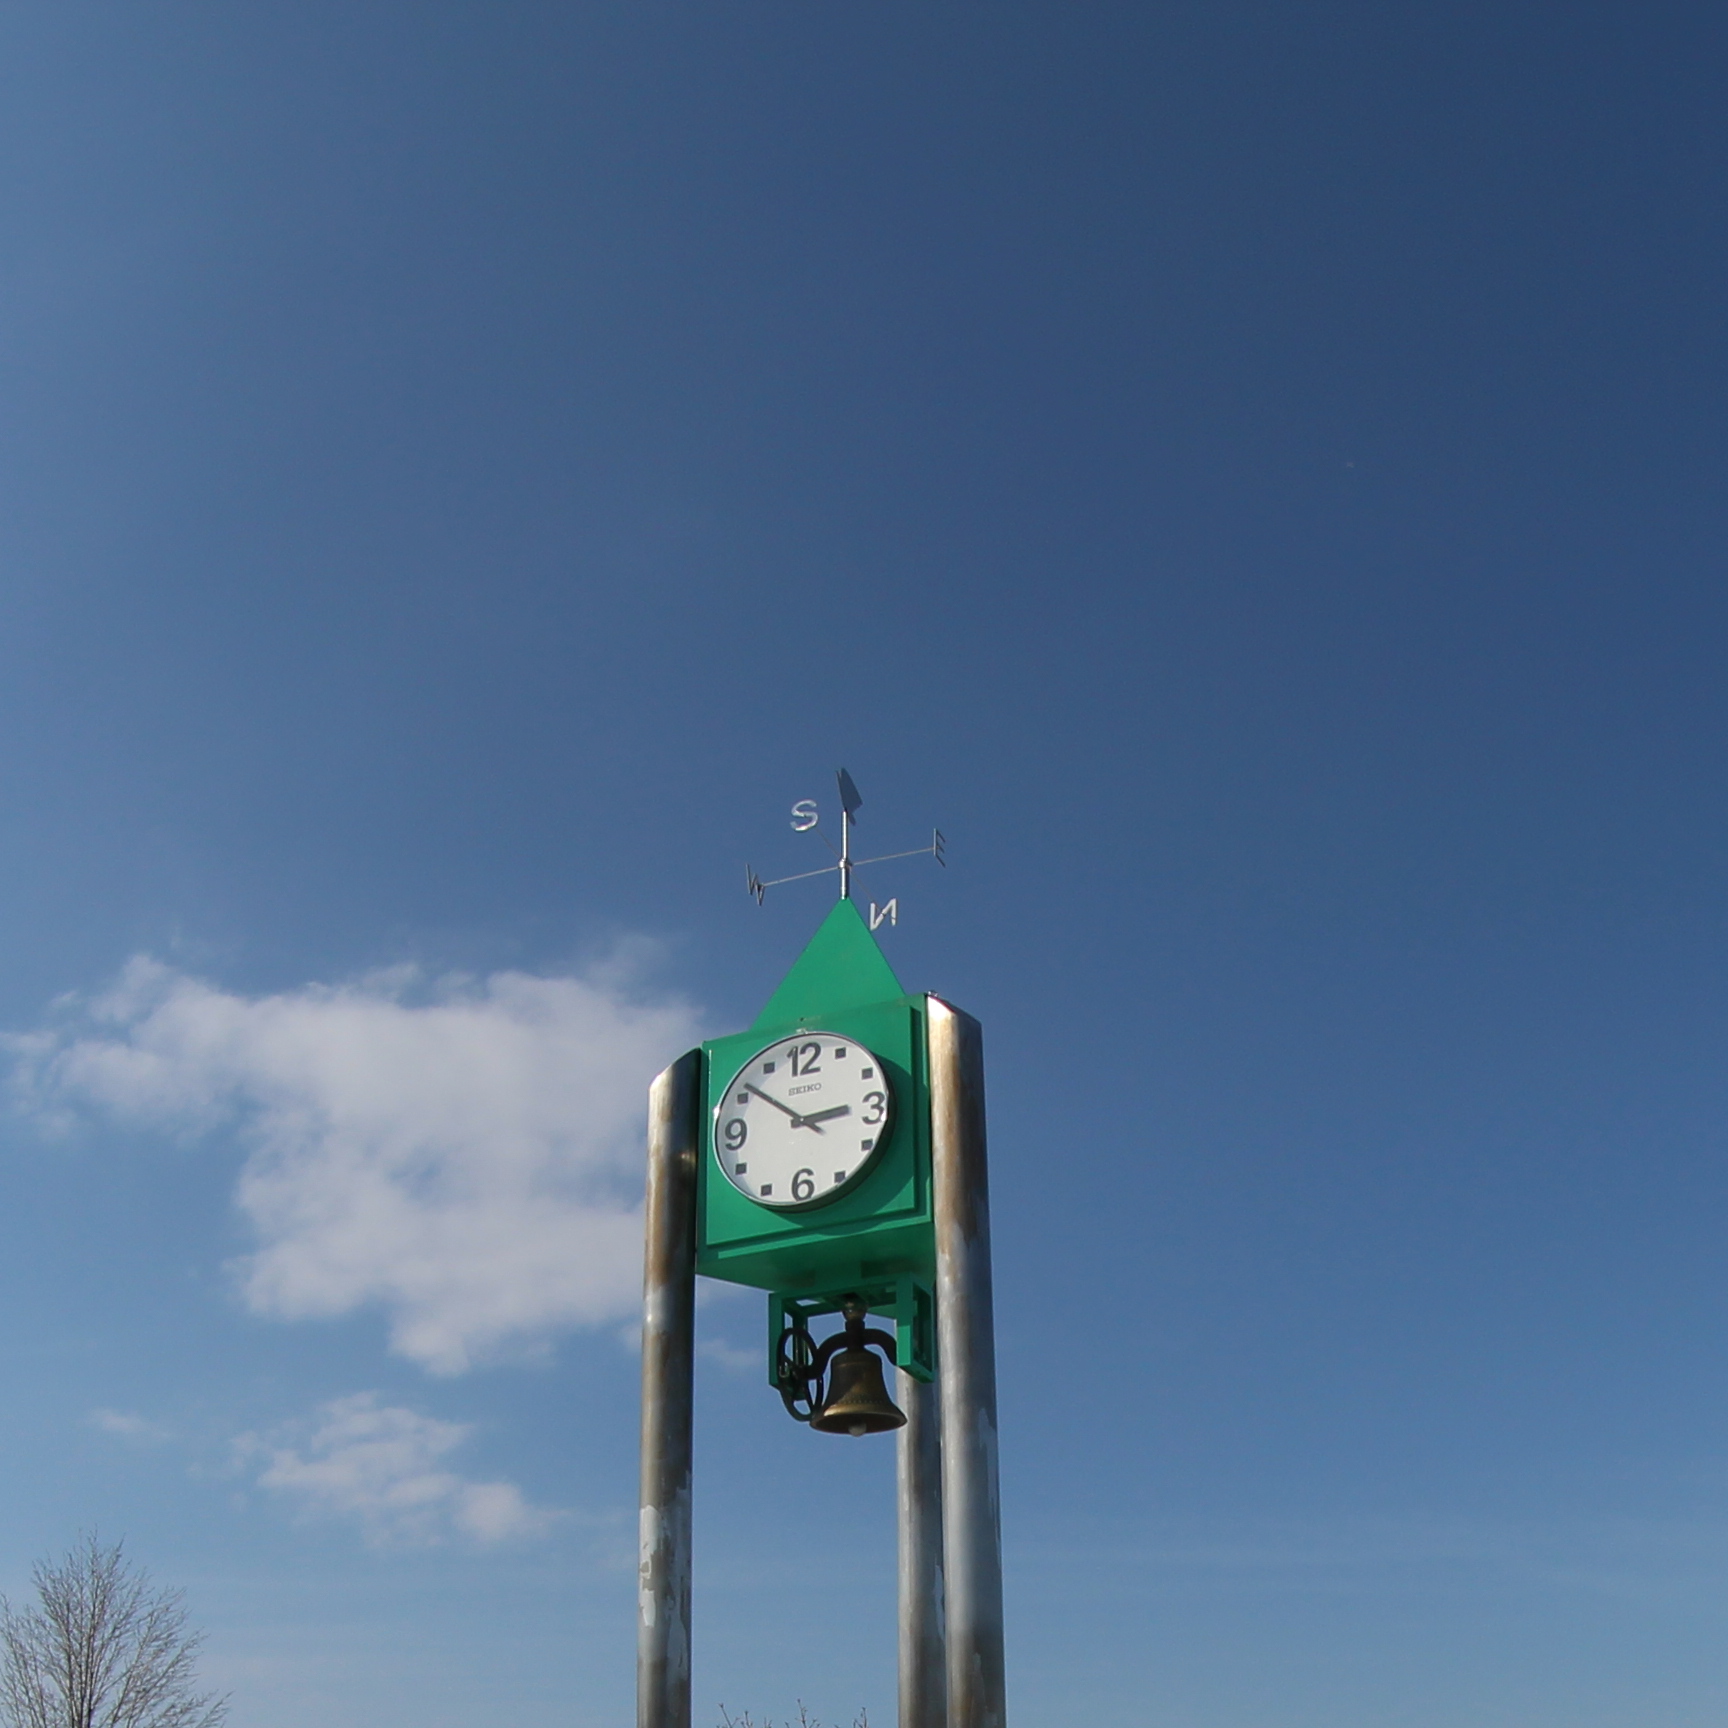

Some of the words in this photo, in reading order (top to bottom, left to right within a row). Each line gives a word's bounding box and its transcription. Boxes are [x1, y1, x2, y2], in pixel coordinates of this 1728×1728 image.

[790, 800, 819, 832] S
[786, 1042, 822, 1077] 12
[788, 1082, 822, 1096] SEIKO
[861, 1091, 885, 1125] 3
[724, 1117, 748, 1151] 9
[790, 1168, 815, 1201] 6
